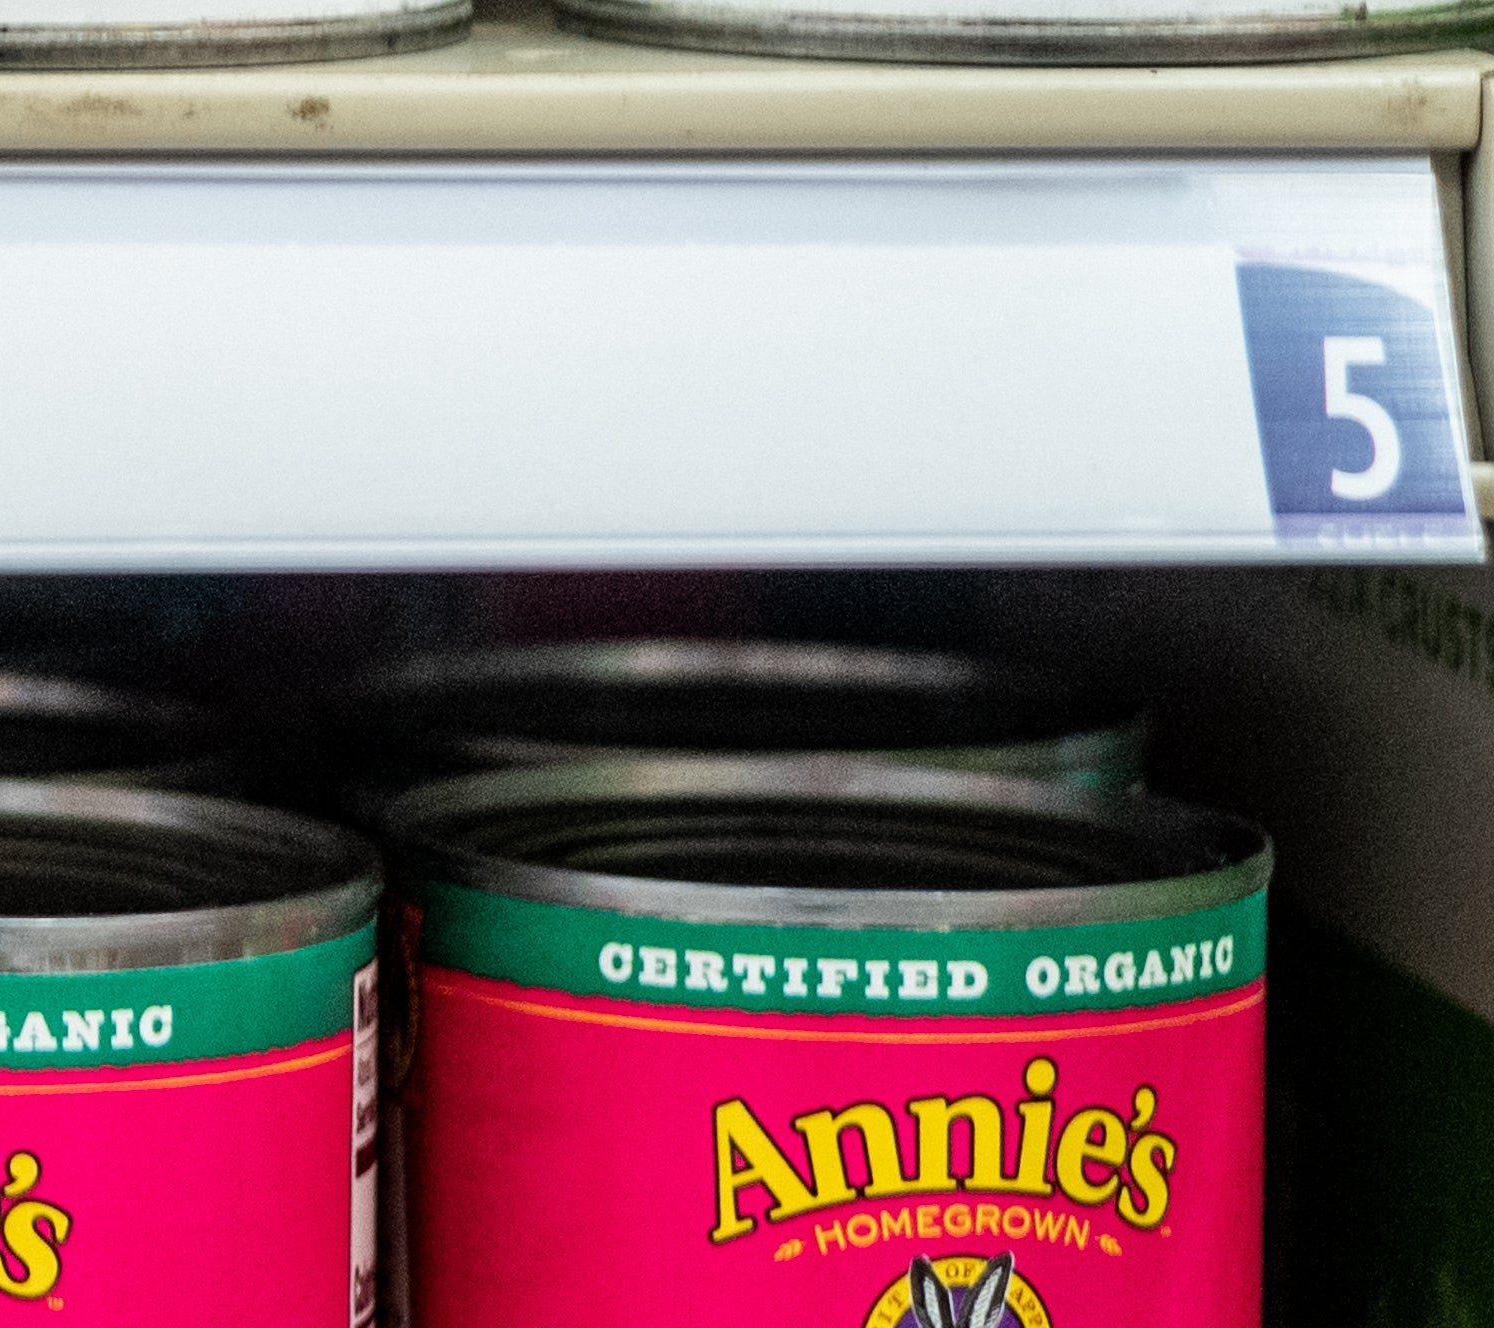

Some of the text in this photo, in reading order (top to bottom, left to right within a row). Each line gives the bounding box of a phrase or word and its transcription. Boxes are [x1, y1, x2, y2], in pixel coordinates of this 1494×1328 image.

[1324, 331, 1405, 499] 5
[594, 935, 1240, 1006] CERTIFIED ORGANIC
[708, 1055, 1176, 1245] Annie's
[815, 1202, 1091, 1255] HOMEGROWN
